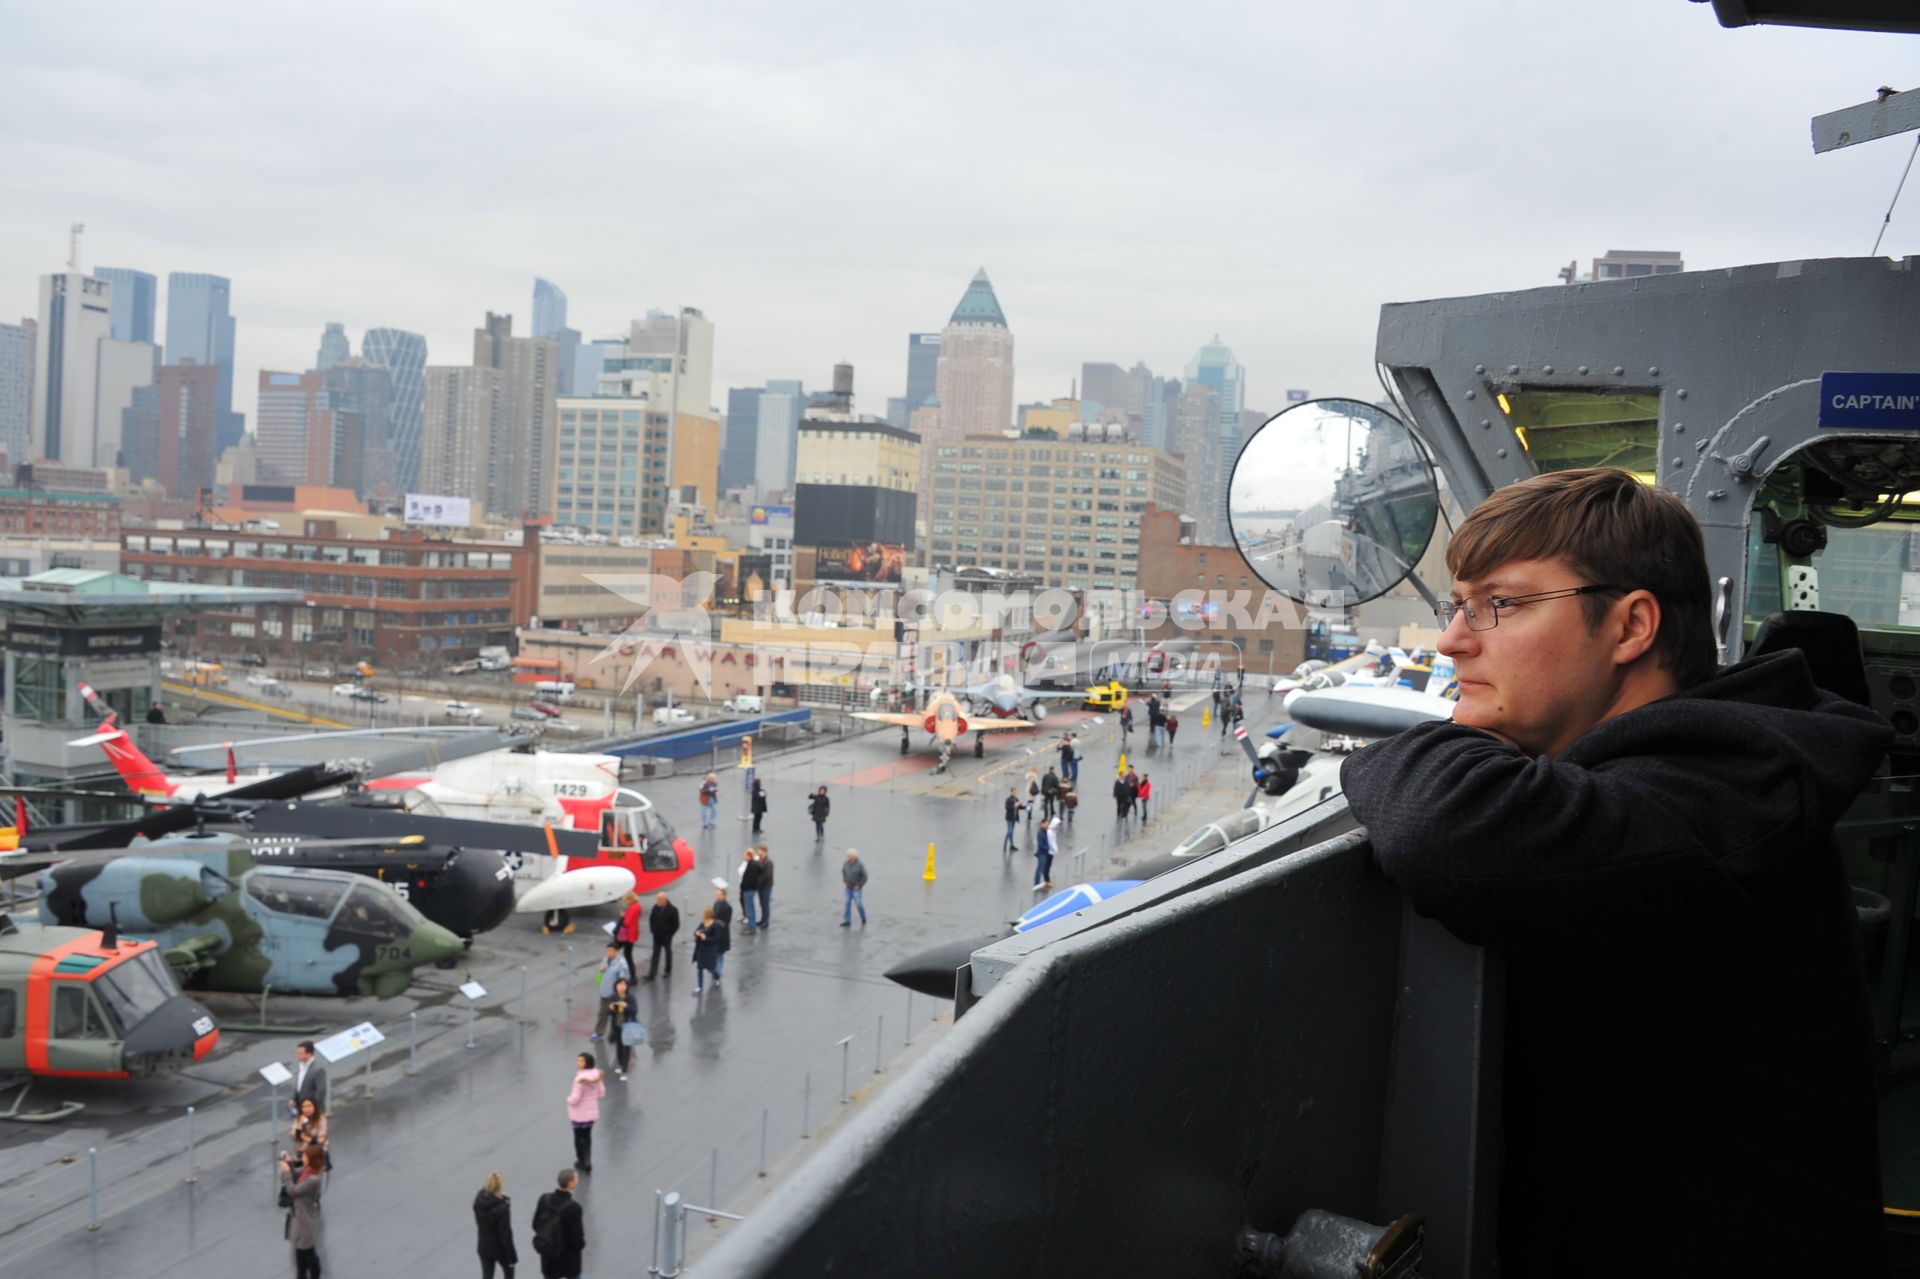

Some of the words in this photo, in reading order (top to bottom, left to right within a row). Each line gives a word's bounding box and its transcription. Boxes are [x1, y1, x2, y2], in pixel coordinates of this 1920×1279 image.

[1832, 394, 1920, 410] CAPTAIN'
[618, 643, 677, 661] CAR
[694, 650, 785, 669] WASH
[553, 783, 588, 797] 1429
[379, 946, 411, 961] 704
